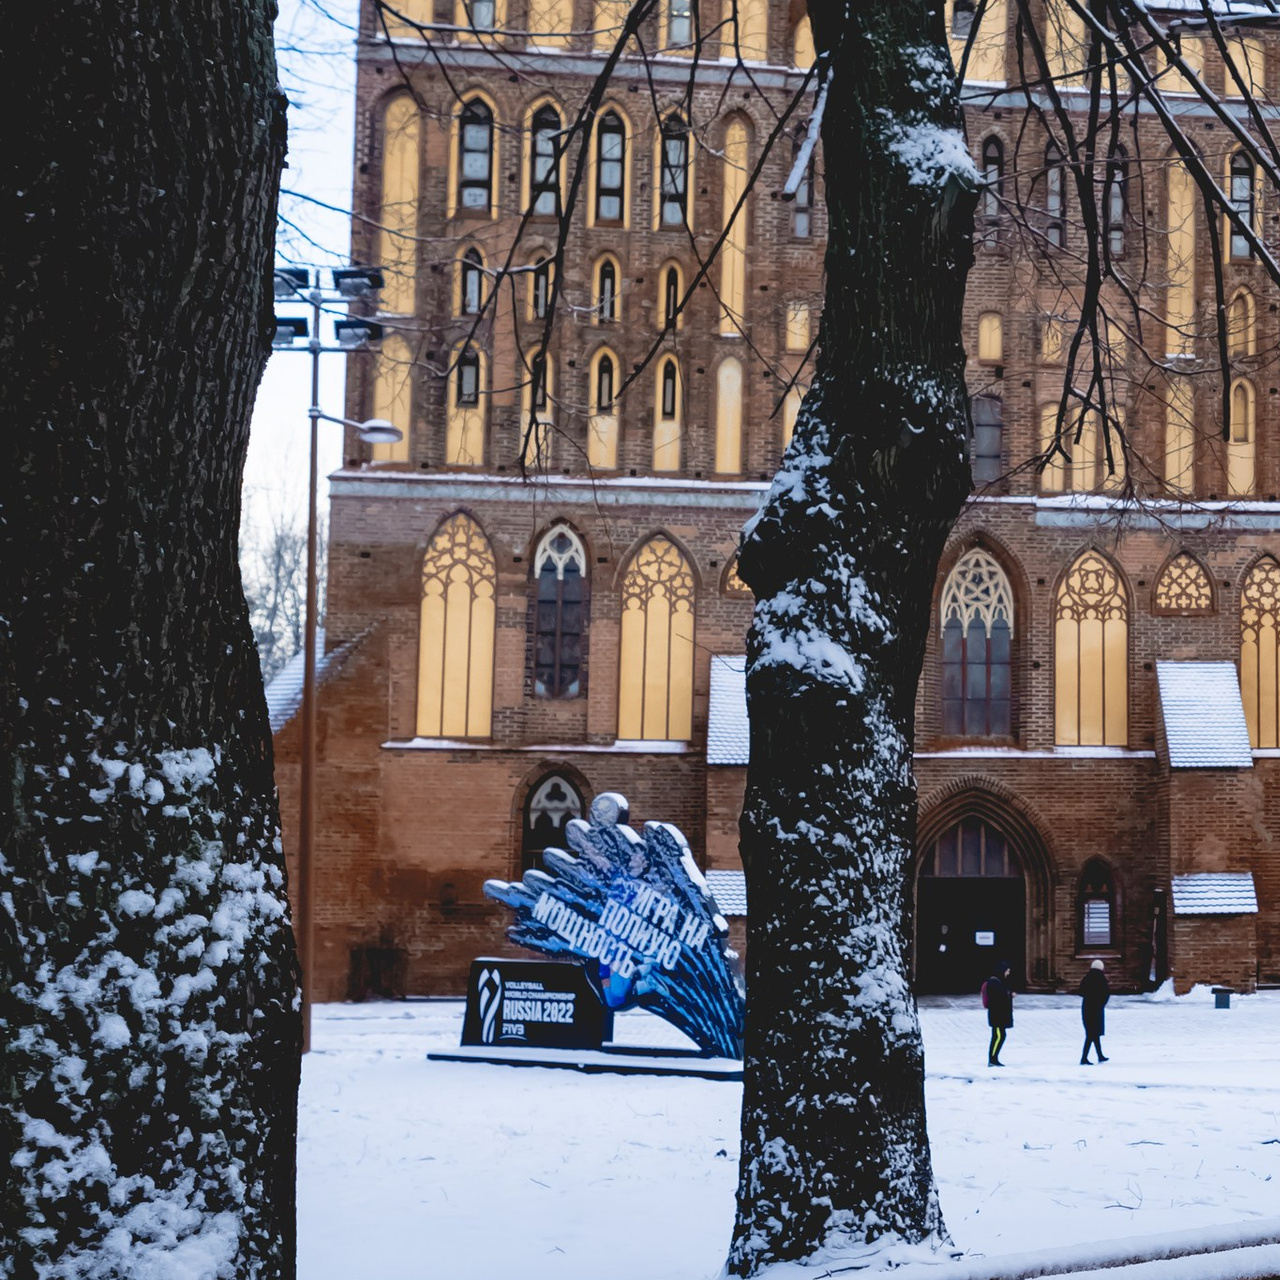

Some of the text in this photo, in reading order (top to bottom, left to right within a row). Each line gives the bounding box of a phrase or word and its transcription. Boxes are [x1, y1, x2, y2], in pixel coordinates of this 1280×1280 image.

[531, 891, 636, 979] МОЩНОСТЬ
[598, 897, 682, 971] ПОЛНУЮ
[630, 884, 710, 952] ИГРА НА
[504, 981, 544, 990] VOLLEYBALL
[504, 990, 576, 1001] WORLD CHAMPIONSHIP
[503, 999, 575, 1024] RUSSIA 2022
